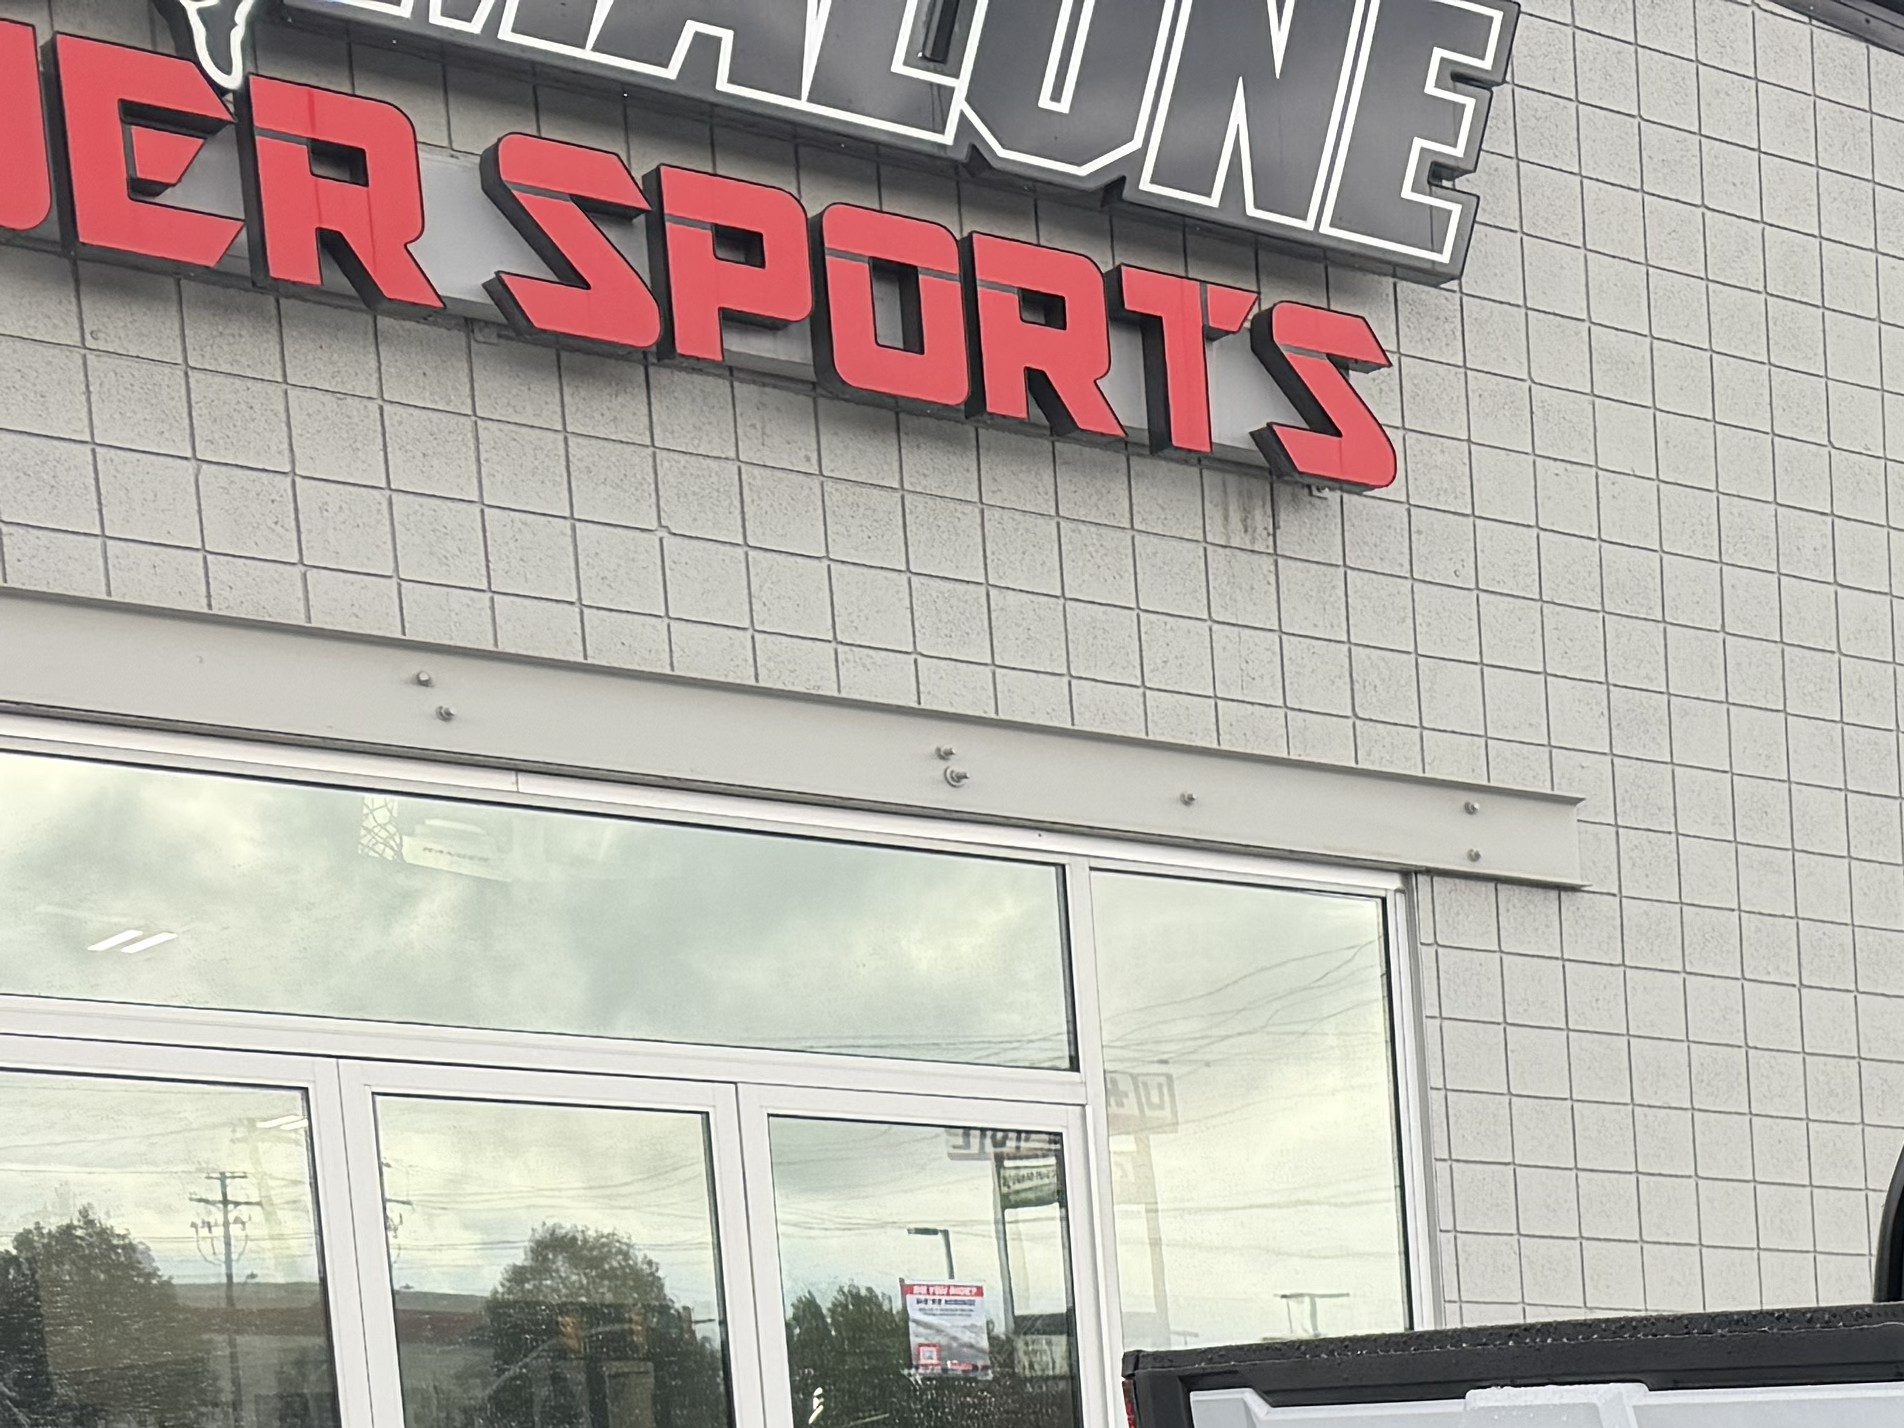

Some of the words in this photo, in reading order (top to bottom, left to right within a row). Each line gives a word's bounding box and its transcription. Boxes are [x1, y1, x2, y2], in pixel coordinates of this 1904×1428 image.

[0, 18, 447, 309] ER
[484, 130, 1398, 490] SPORTS
[283, 0, 1504, 263] LONE
